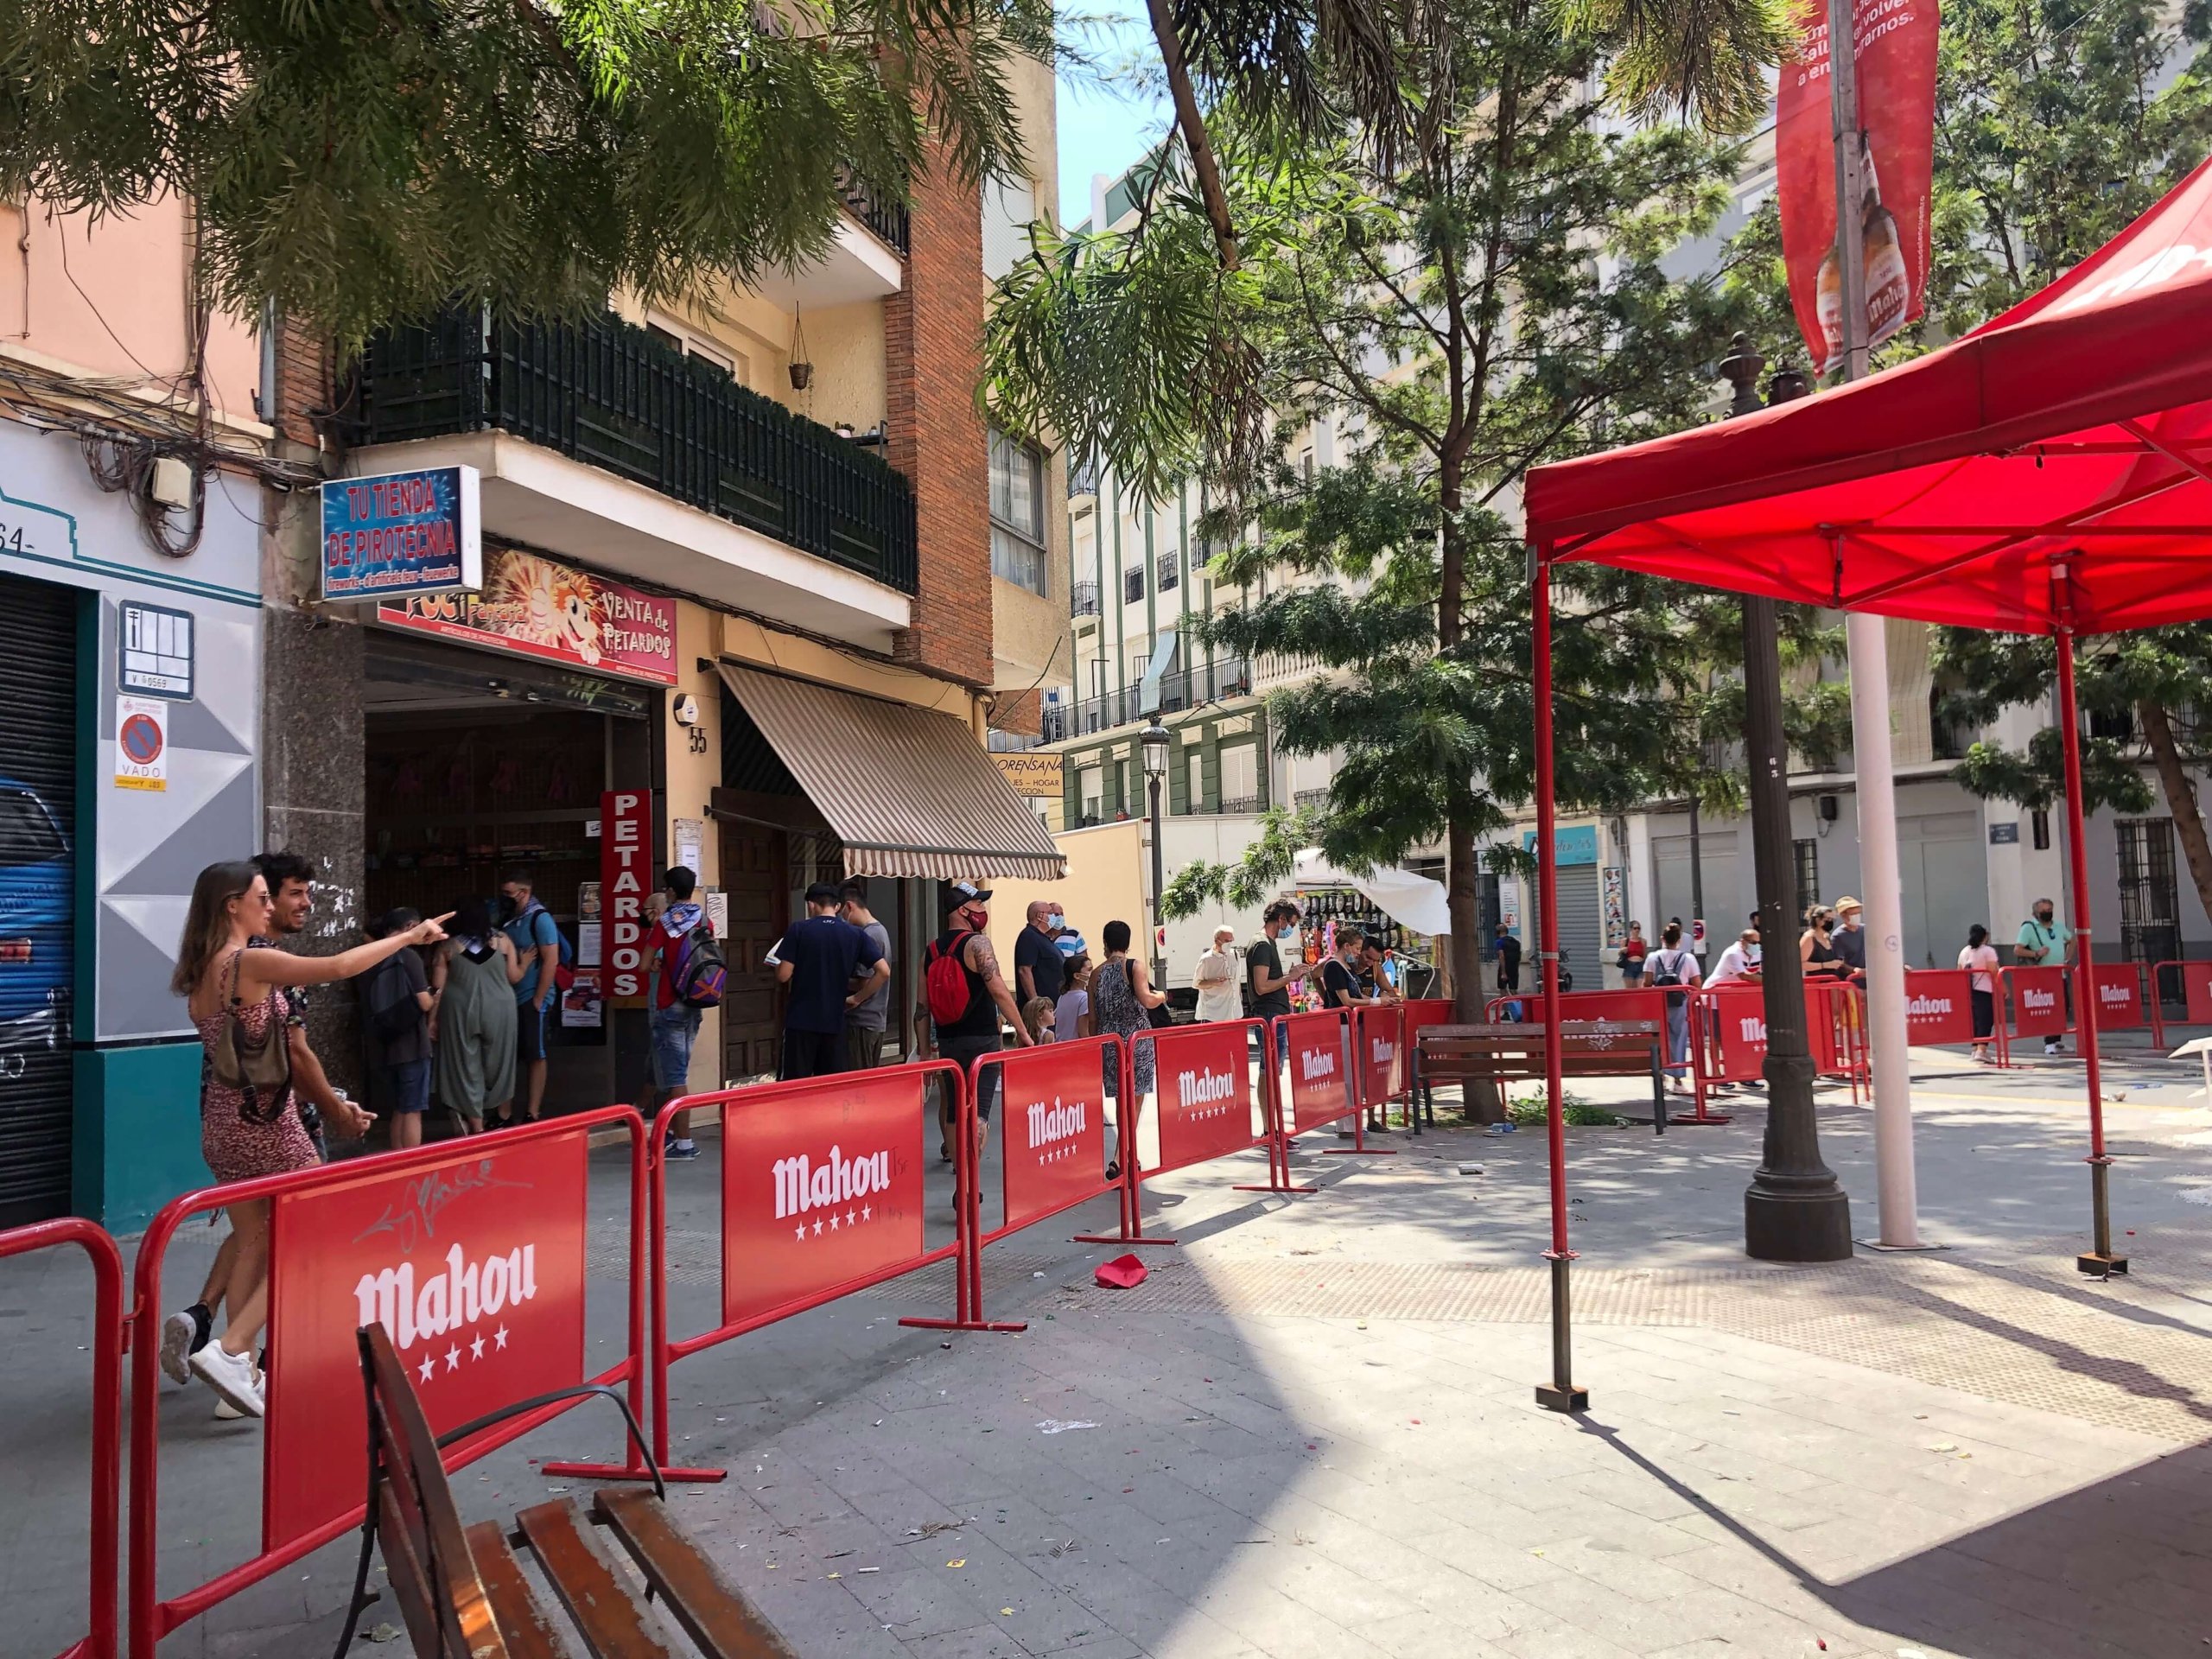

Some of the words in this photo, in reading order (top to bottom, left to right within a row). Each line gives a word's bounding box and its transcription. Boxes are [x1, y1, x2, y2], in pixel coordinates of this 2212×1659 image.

[1863, 0, 1910, 27] volve
[1798, 73, 1806, 86] a
[1868, 285, 1904, 323] Maho
[347, 485, 370, 522] TU
[372, 477, 437, 519] TIENDA
[328, 531, 352, 568] DE
[354, 518, 457, 565] PIROTECNIA
[601, 591, 654, 624] VENTA
[655, 608, 670, 632] de
[602, 622, 671, 659] PETARDOS
[690, 726, 707, 753] 55
[122, 764, 161, 778] VADO
[1033, 779, 1059, 787] HOGAR
[612, 795, 641, 996] PETARDOS
[2023, 988, 2055, 1009] Mahou
[2100, 983, 2131, 1003] Mahou
[1301, 1046, 1334, 1080] Mahou
[1372, 1035, 1395, 1064] Mahou
[1178, 1065, 1234, 1108] Mahou
[1027, 1094, 1087, 1149] Mahou
[772, 1144, 891, 1219] Mahou
[353, 1242, 538, 1351] Mahou
